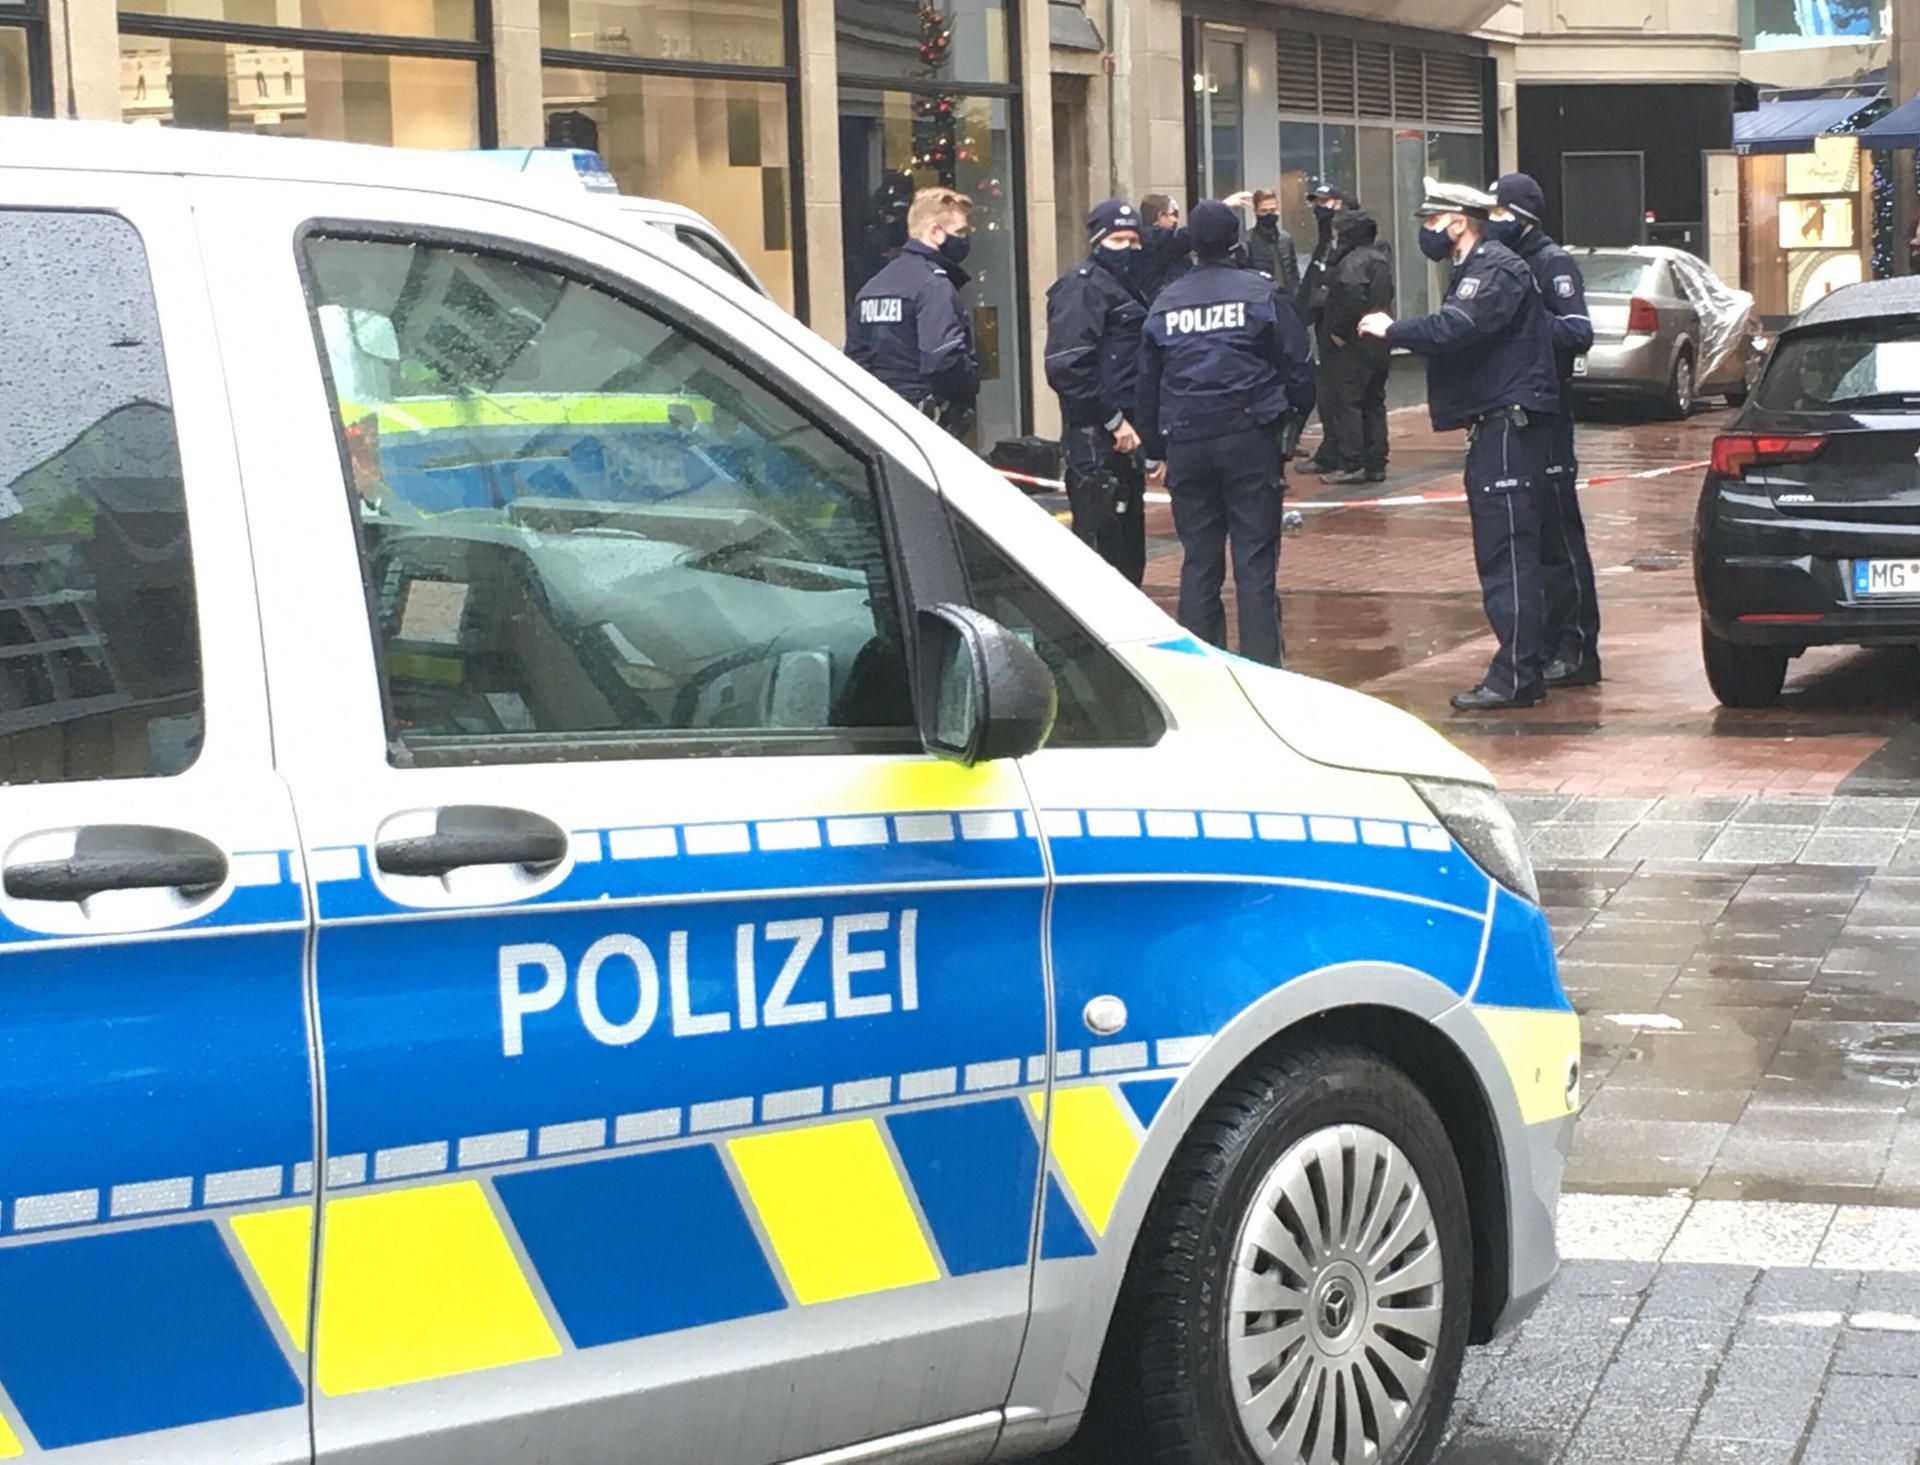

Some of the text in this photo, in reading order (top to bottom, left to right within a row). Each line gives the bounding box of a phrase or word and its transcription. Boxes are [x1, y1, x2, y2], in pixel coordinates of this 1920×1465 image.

[861, 298, 902, 323] POLIZEI
[1166, 302, 1245, 336] POLIZEI
[1778, 494, 1815, 502] ASTRA
[1871, 563, 1905, 588] MG
[498, 908, 920, 1057] POLIZEI
